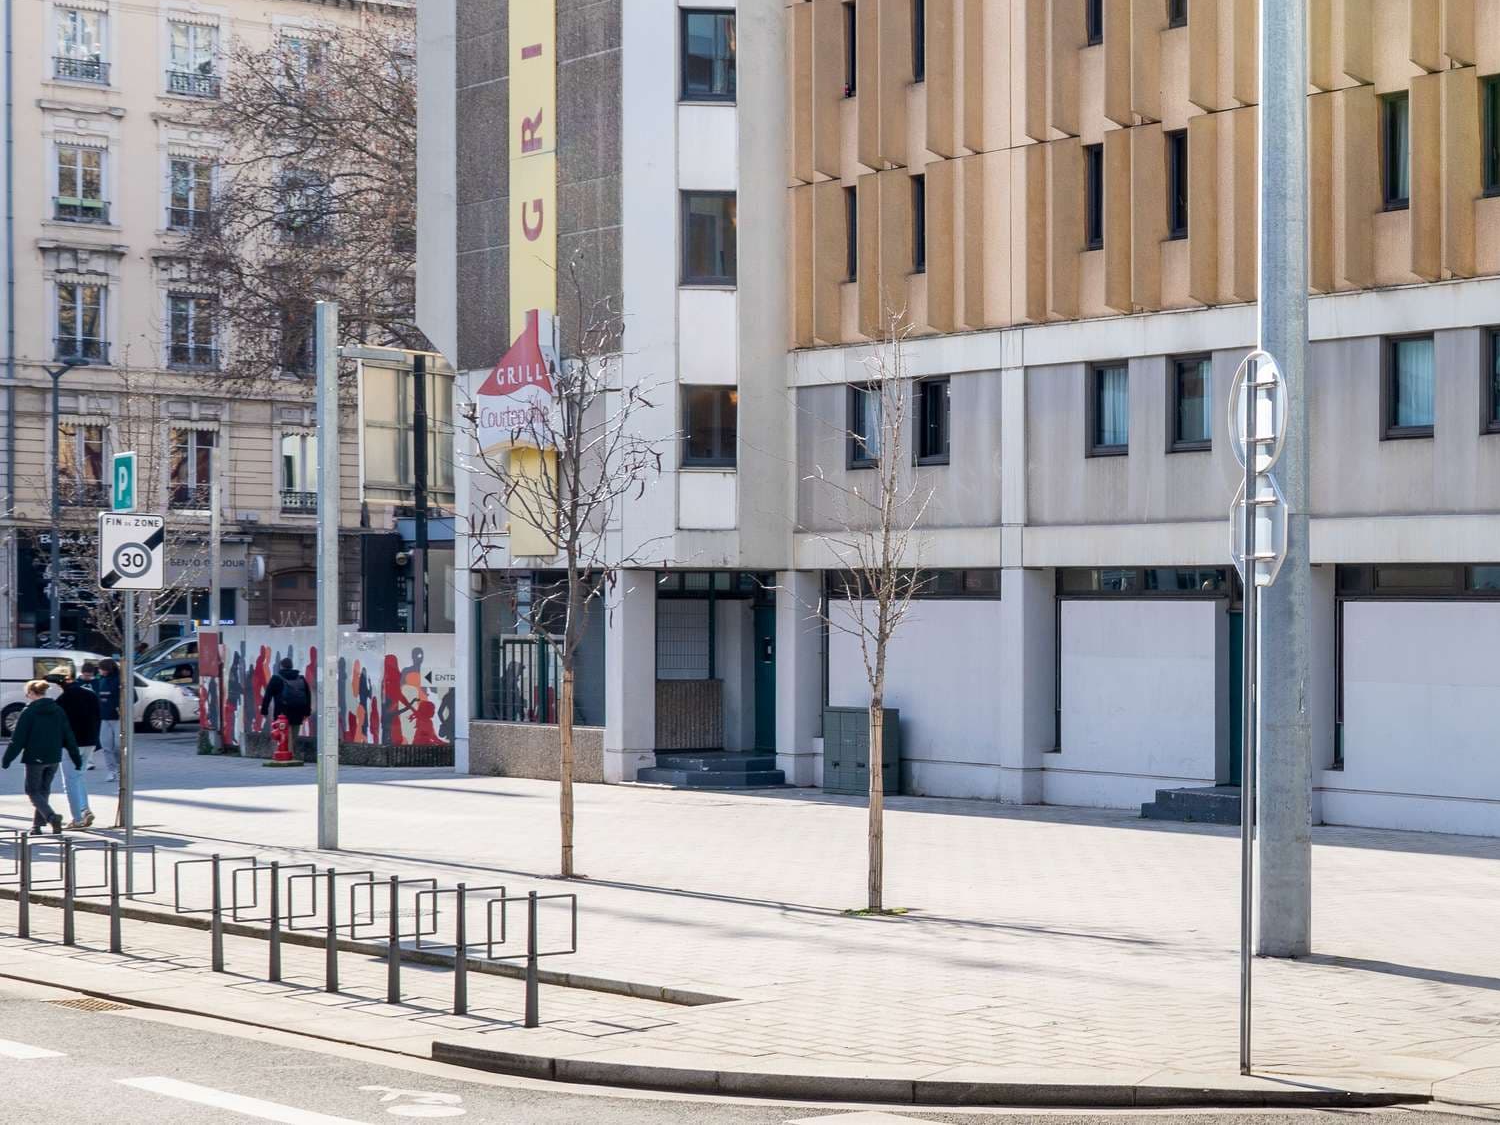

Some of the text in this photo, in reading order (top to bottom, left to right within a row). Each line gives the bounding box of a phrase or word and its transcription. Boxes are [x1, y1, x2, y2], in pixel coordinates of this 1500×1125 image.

[496, 363, 543, 385] GRILL
[118, 466, 128, 501] P
[105, 517, 122, 527] FIN
[134, 519, 160, 528] ZONE
[121, 553, 144, 567] 30
